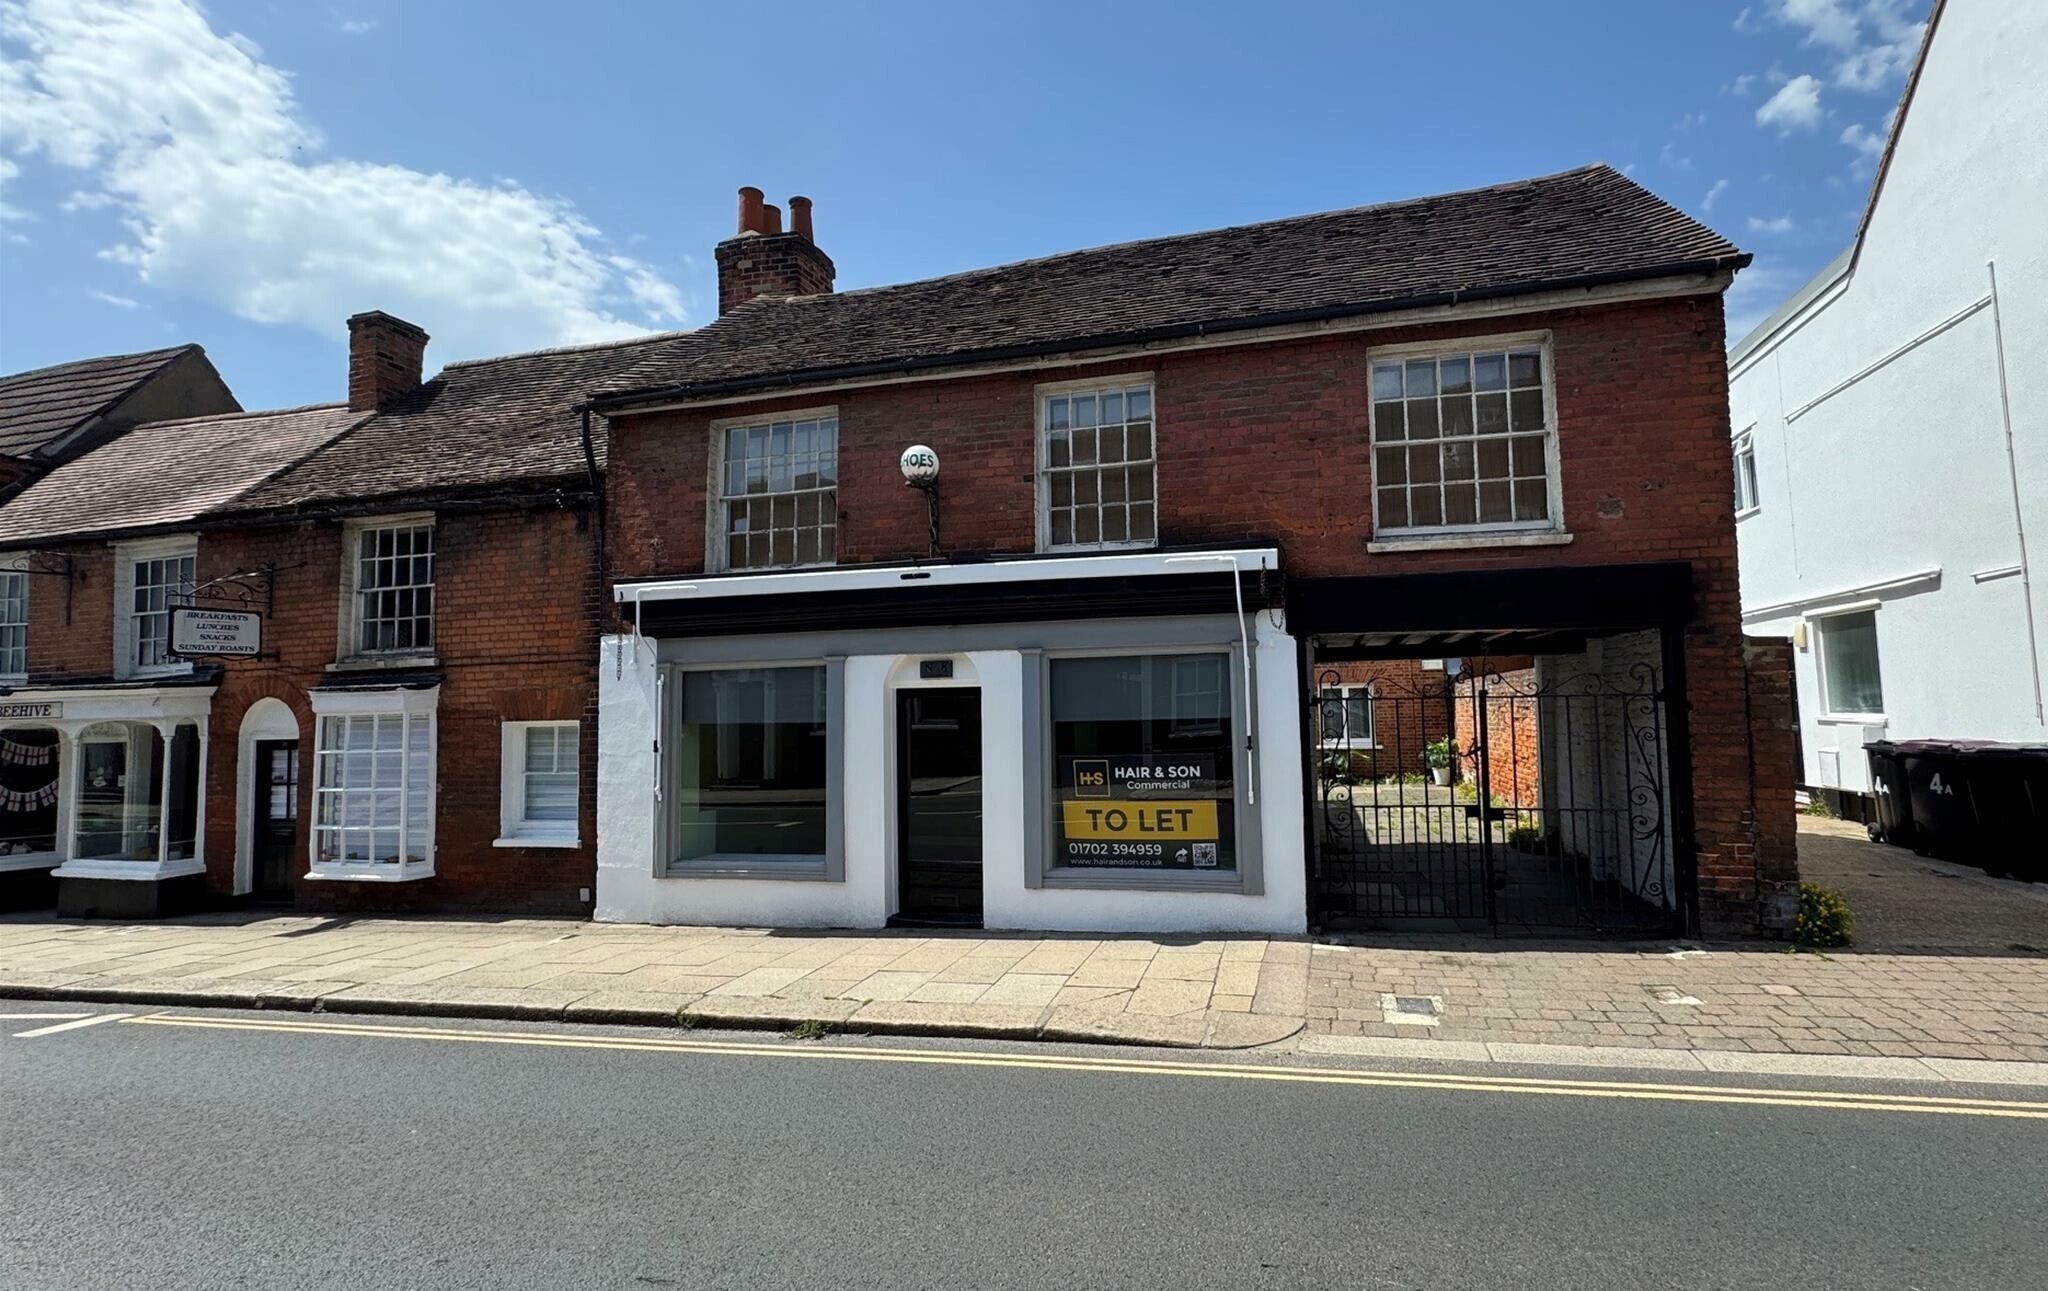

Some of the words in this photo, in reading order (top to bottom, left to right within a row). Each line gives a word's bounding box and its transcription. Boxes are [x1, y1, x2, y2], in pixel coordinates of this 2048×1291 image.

[186, 611, 249, 621] BREAKFASTS
[196, 623, 240, 631] LUNCHES
[200, 633, 236, 641] SNACKS
[178, 643, 217, 651] SUNDAY
[1114, 766, 1150, 779] HAIR
[1154, 766, 1164, 778] &
[1168, 765, 1201, 778] SON
[1126, 779, 1190, 790] Commercial
[1085, 808, 1128, 832] TO
[1138, 808, 1193, 832] LET
[1068, 842, 1109, 855] 01702
[1112, 843, 1162, 856] 394959
[1070, 857, 1163, 866] www.hairandson.co.uk
